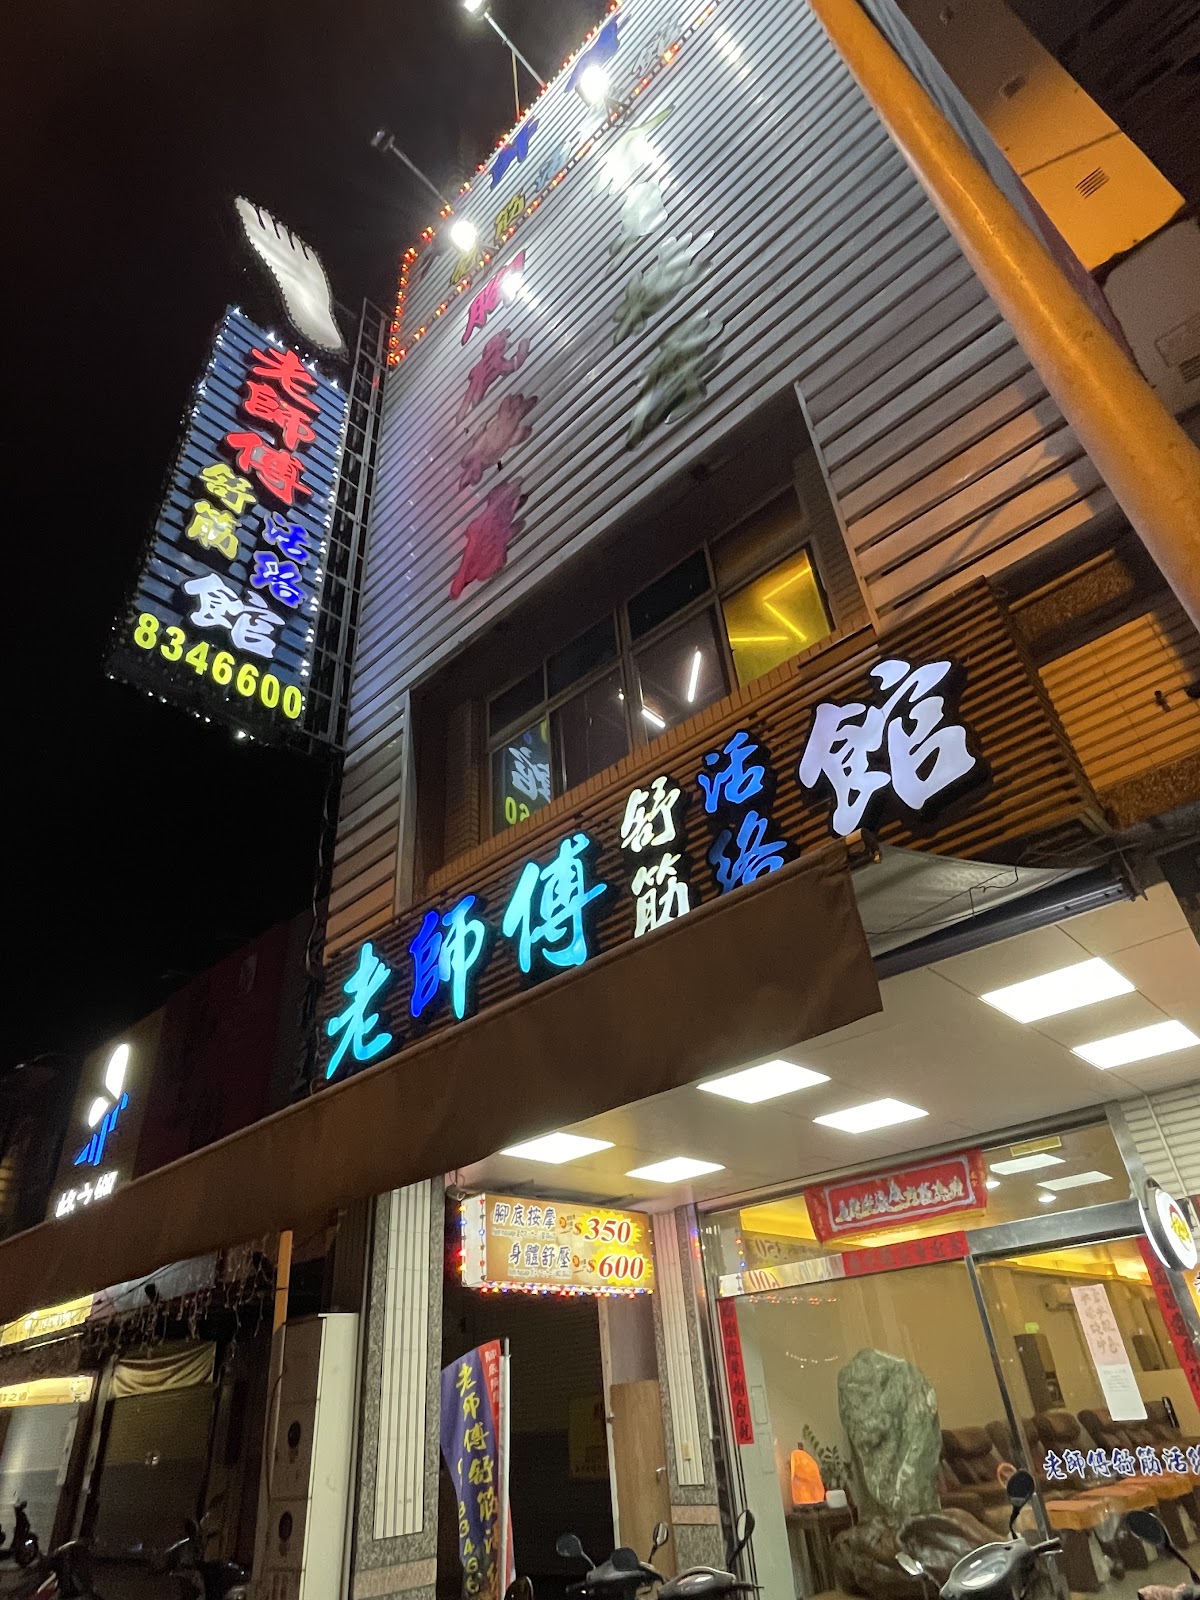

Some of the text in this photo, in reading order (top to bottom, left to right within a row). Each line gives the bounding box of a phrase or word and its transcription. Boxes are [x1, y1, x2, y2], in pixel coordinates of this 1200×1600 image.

[226, 347, 320, 505] 老師傅
[186, 463, 257, 560] 舒筋
[252, 511, 312, 607] 活絡
[184, 573, 285, 659] 館
[133, 612, 303, 720] 8346600
[799, 659, 976, 836] 館
[620, 776, 691, 939] 舒筋
[326, 832, 606, 1079] 老師傅
[494, 1203, 557, 1229] 腳底按摩
[509, 1242, 571, 1269] 身體舒壓
[573, 1217, 631, 1244] $350
[587, 1255, 645, 1281] $600
